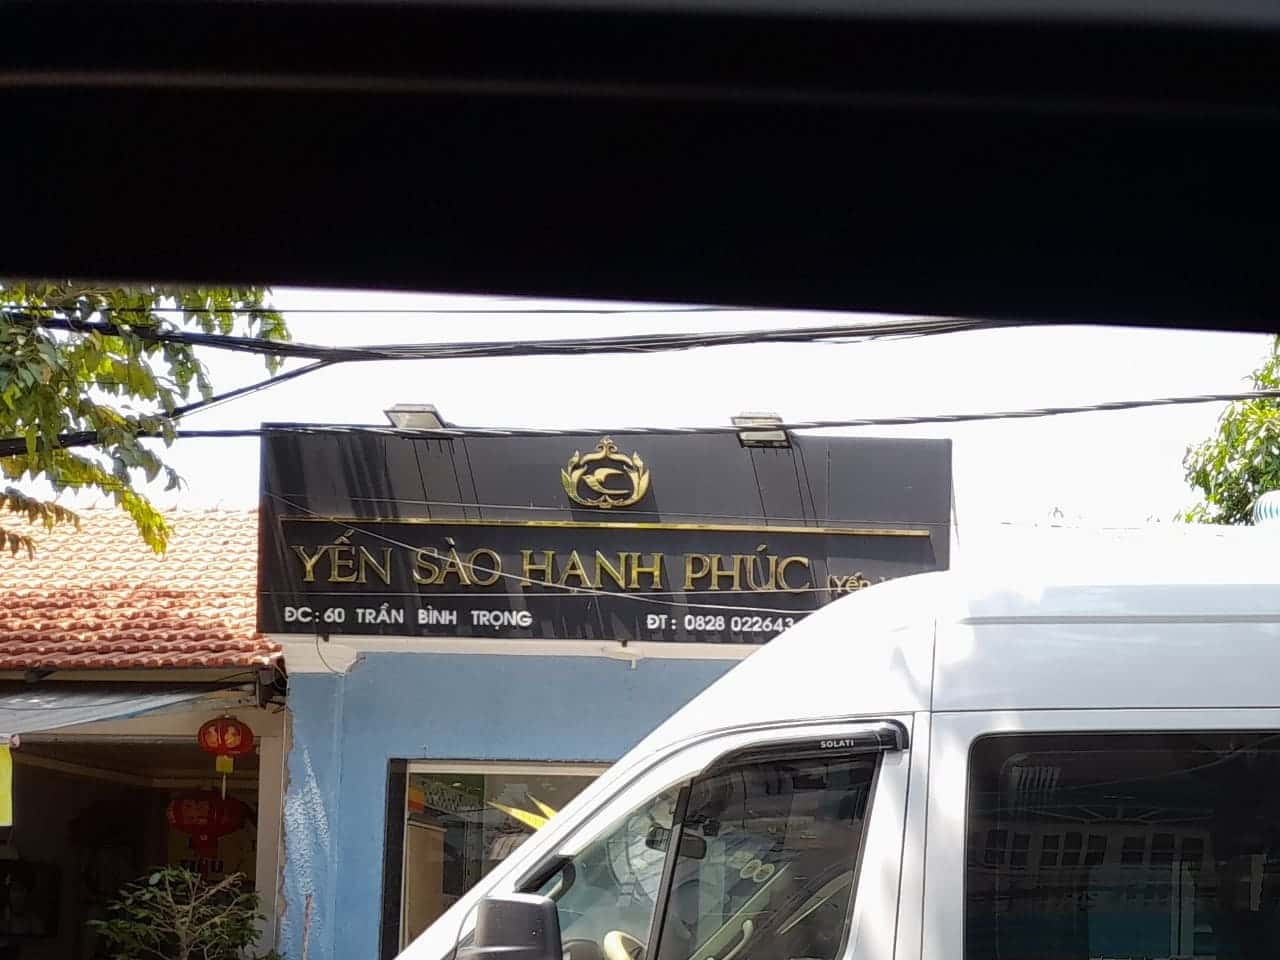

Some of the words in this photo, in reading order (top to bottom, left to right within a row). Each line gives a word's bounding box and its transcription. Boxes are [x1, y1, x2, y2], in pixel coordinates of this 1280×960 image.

[292, 529, 393, 585] YẾN
[412, 537, 502, 586] SÀO
[683, 544, 811, 594] PHÚC
[323, 606, 345, 623] 60
[355, 602, 404, 624] TRẦN
[418, 604, 457, 625] BÌNH
[471, 610, 533, 630] TRỌNG
[684, 614, 725, 631] 0828
[820, 739, 855, 749] SOLATI
